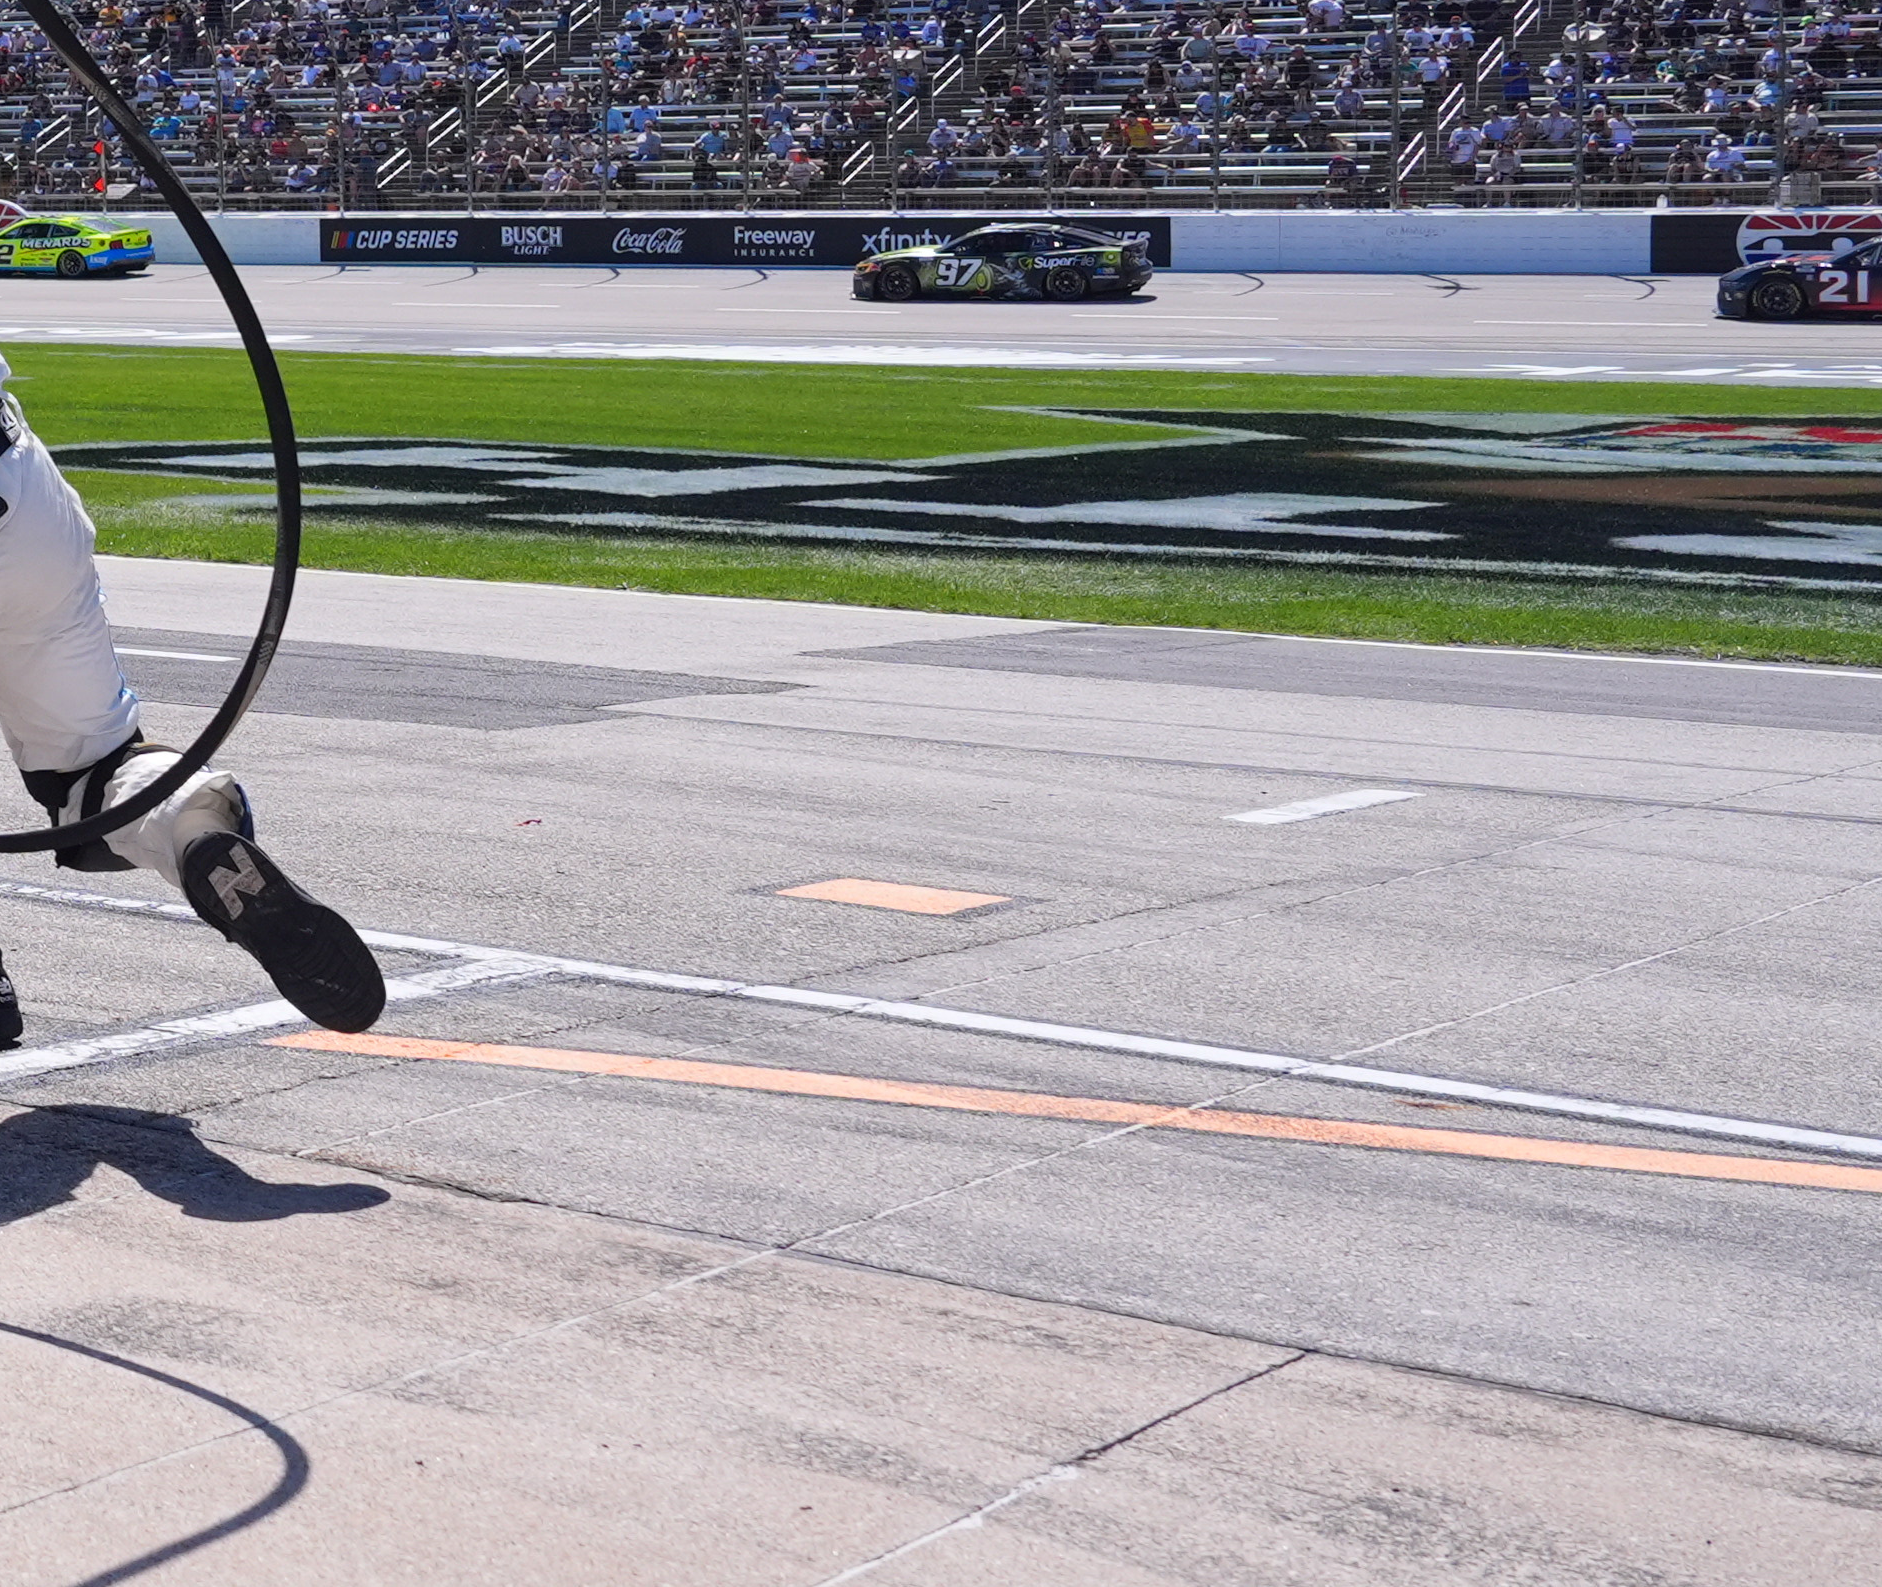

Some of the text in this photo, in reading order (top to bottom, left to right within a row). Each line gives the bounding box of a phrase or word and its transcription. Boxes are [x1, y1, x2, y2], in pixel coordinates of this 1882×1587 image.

[21, 237, 91, 250] MENARDS
[356, 229, 459, 249] CUP SERIES
[500, 225, 564, 248] BUSCH
[611, 226, 688, 255] Coca-Cola
[734, 225, 815, 250] Freeway
[861, 226, 952, 254] xfinity
[513, 246, 550, 257] LIGHT
[734, 248, 815, 257] INSURANCE
[1033, 254, 1095, 270] SuperFile
[936, 257, 986, 287] 97
[1818, 270, 1871, 304] 21
[207, 841, 267, 922] N
